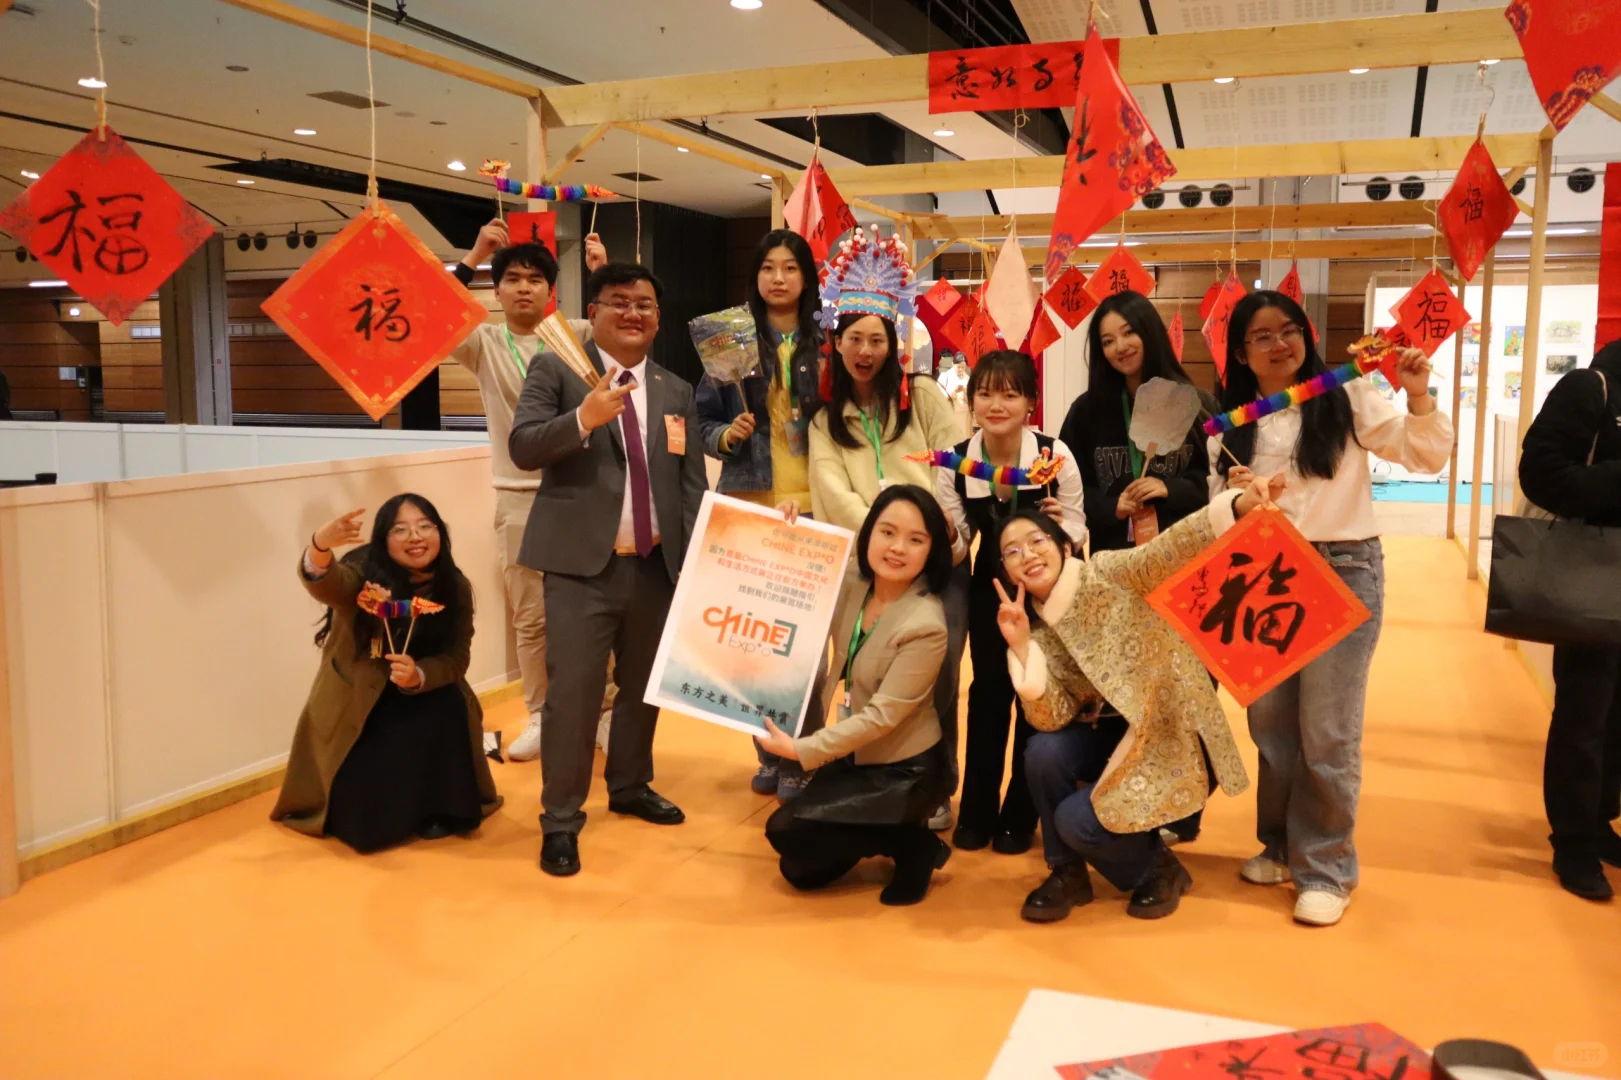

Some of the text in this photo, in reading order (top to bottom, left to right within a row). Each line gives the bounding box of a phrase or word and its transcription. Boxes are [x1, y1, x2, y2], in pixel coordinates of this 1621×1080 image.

[1459, 183, 1484, 224] 福
[39, 190, 149, 275] 福
[348, 284, 411, 342] 福
[1414, 291, 1451, 342] 福
[761, 537, 796, 555] CHINE
[1199, 552, 1306, 654] 福
[680, 682, 729, 708] 东方之美
